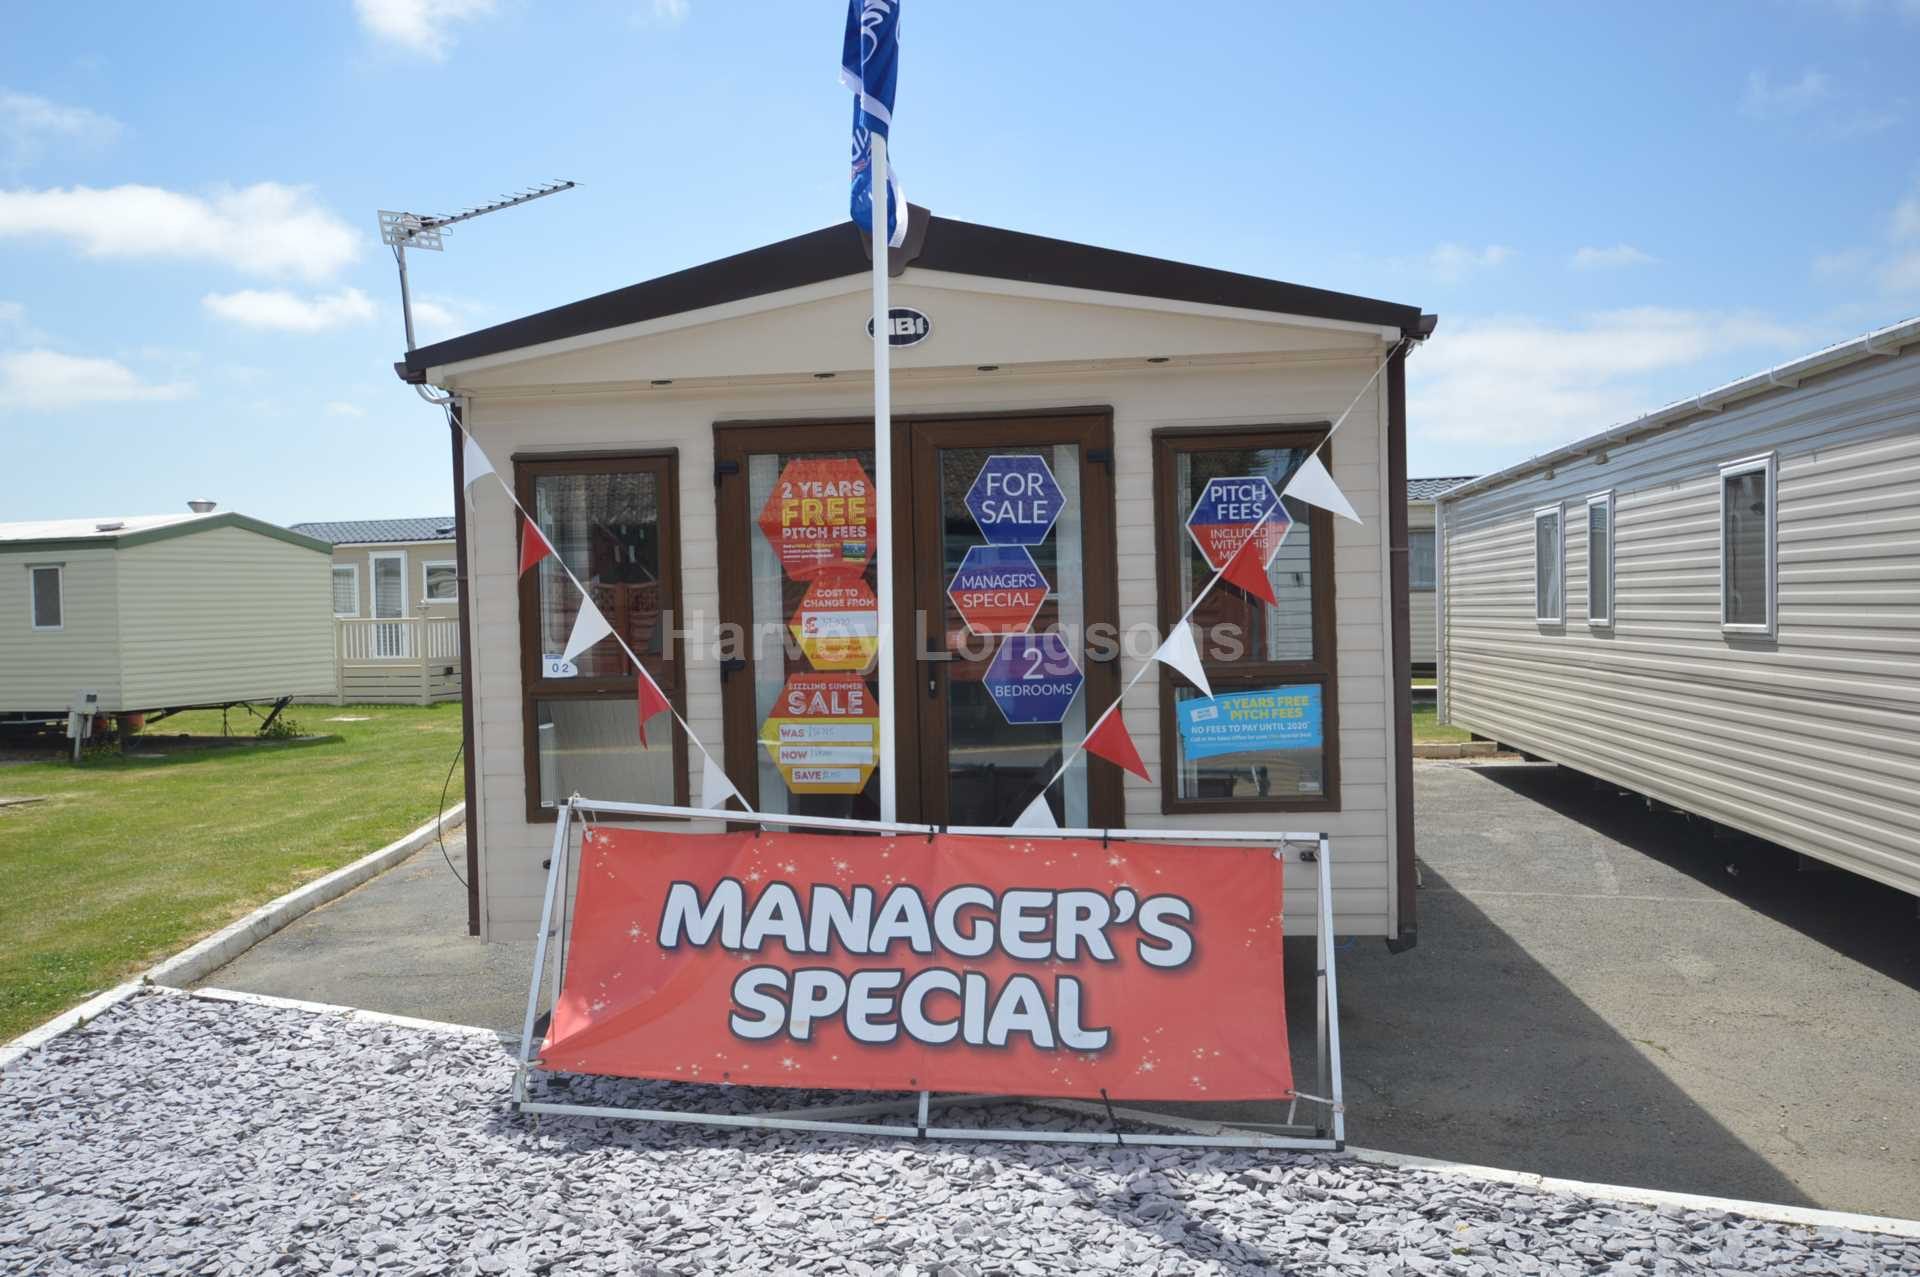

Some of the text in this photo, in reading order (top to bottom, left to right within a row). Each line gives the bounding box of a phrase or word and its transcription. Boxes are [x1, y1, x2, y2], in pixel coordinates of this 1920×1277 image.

[782, 480, 866, 498] 2 YEARS
[986, 472, 1045, 497] FOR
[1210, 485, 1266, 502] PITCH
[782, 497, 867, 527] FREE
[981, 500, 1049, 524] SALE
[1217, 503, 1264, 520] FEES
[782, 525, 867, 540] PITCH FEES
[1210, 527, 1268, 539] INCLUDED
[961, 573, 1037, 589] MANAGER'S
[816, 588, 858, 598] COST TO
[962, 592, 1035, 608] SPECIAL
[803, 599, 875, 608] CHANGE FROM
[1022, 647, 1044, 680] 2
[995, 683, 1073, 697] BEDROOMS
[787, 690, 864, 715] SALE
[1233, 697, 1276, 709] YEARS
[1278, 695, 1310, 706] FREE
[1231, 708, 1270, 721] PITCH
[1272, 707, 1303, 719] FEES
[781, 728, 805, 737] WAS
[781, 750, 808, 759] NOW
[794, 770, 822, 780] SAVE
[658, 877, 1194, 968] MANAGER'S
[729, 965, 1110, 1052] SPECIAL
